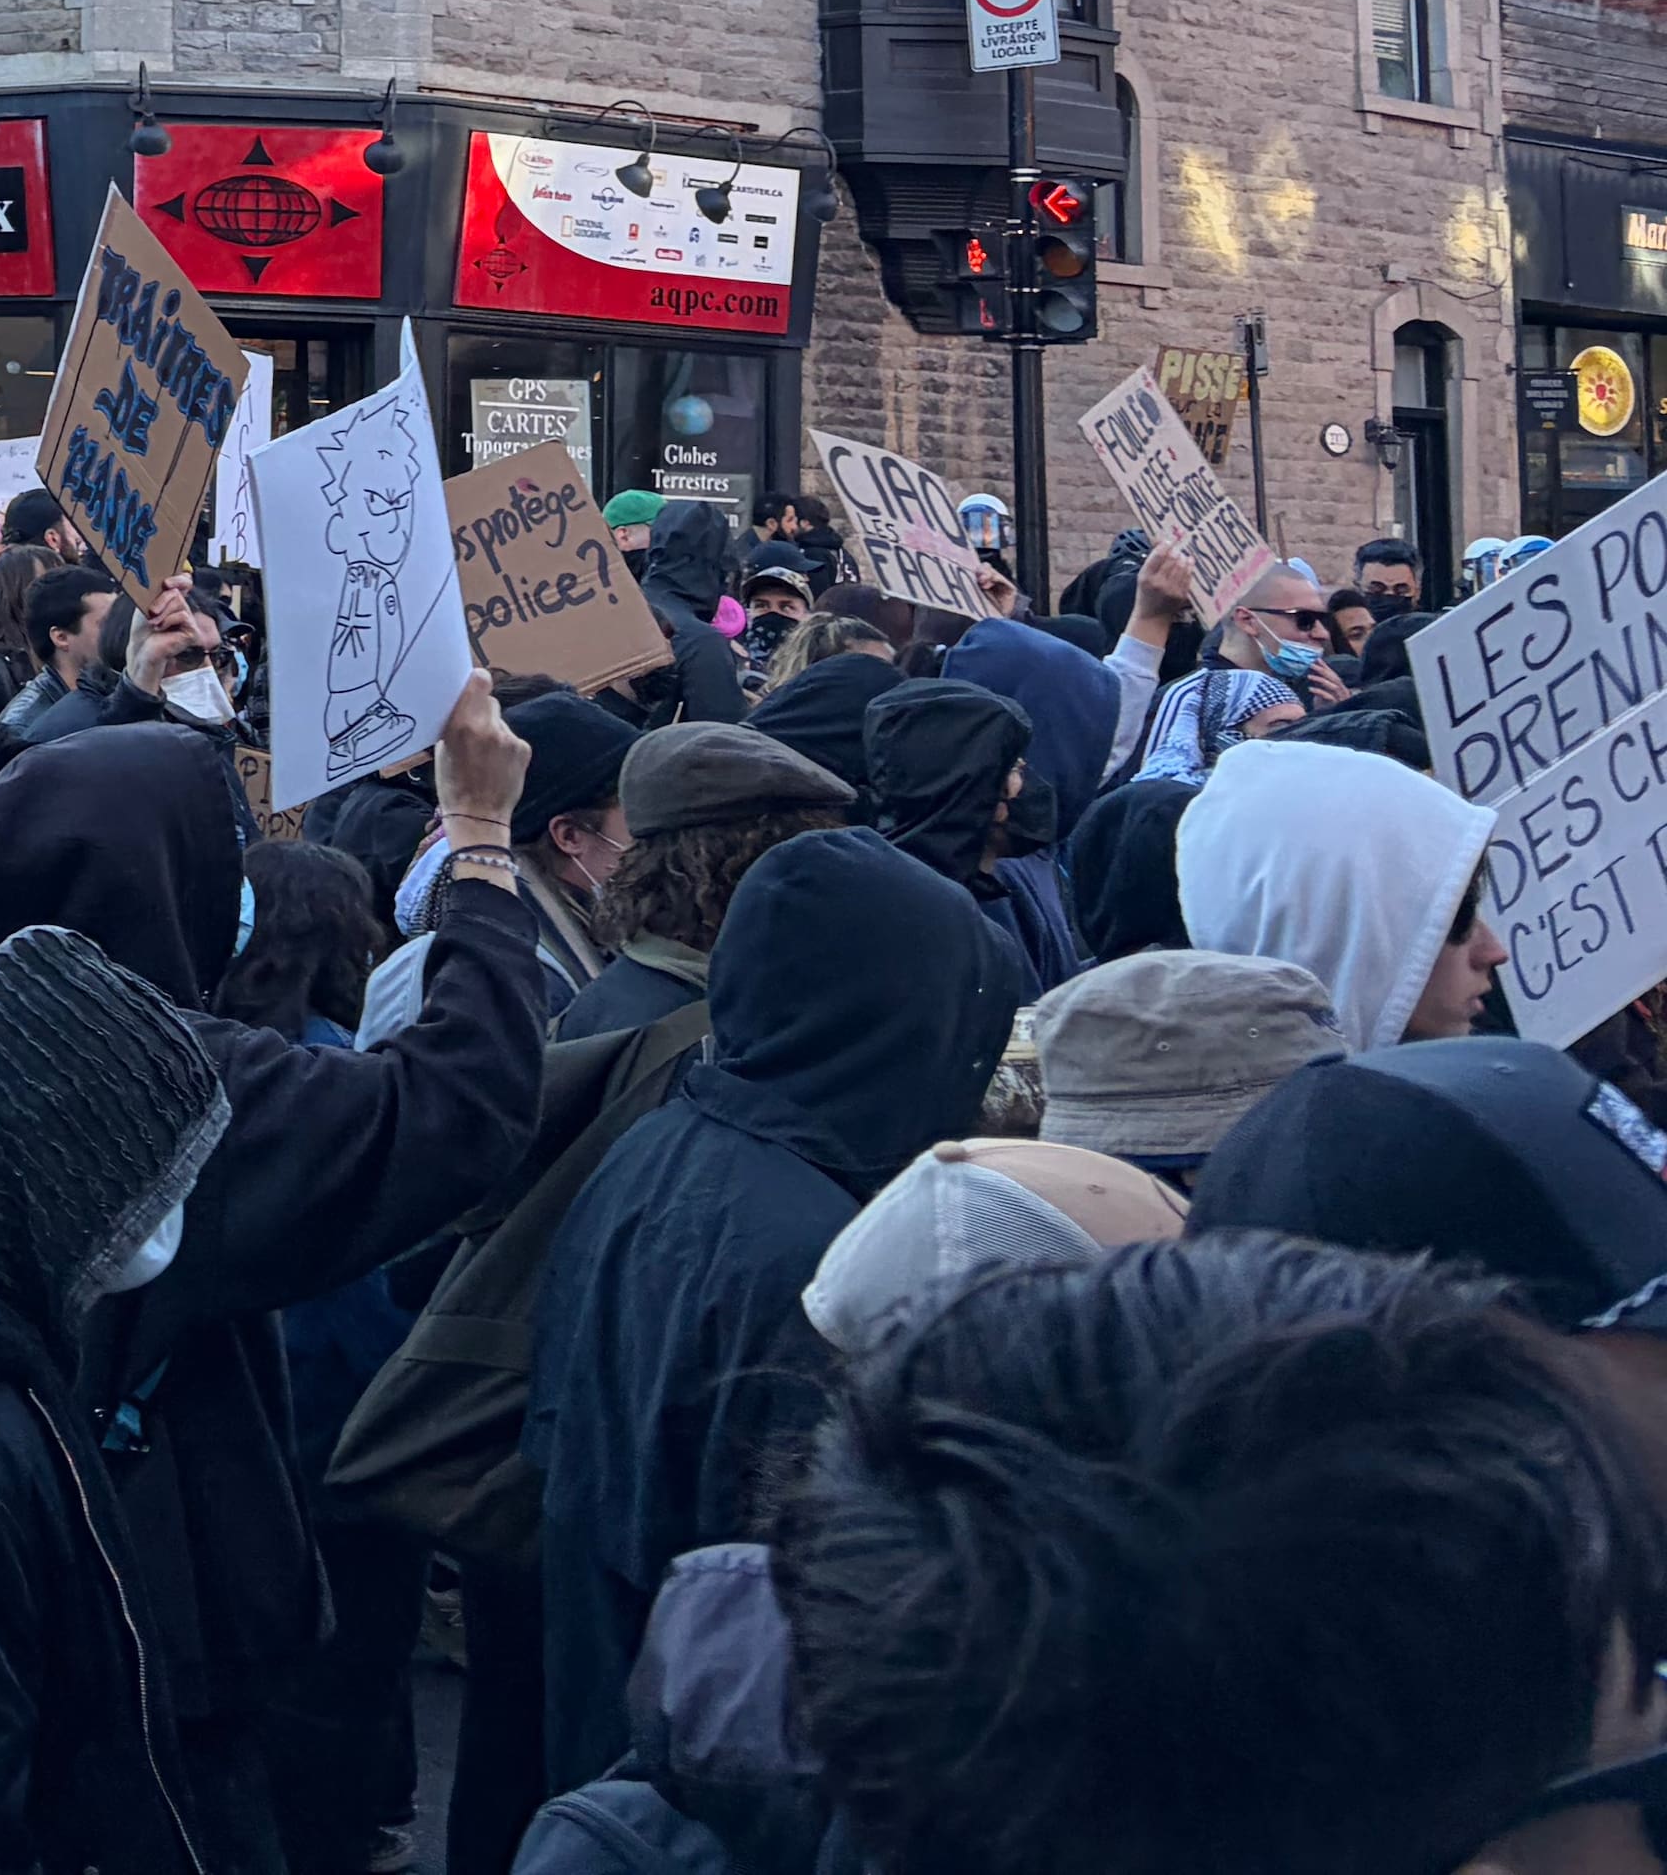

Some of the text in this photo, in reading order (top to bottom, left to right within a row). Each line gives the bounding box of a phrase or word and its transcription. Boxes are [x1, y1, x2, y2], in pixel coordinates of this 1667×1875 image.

[981, 31, 1046, 48] LIVRAISON
[986, 18, 1038, 36] EXCEPTÉ
[991, 44, 1037, 59] LOCALE
[1627, 212, 1667, 251] Mar
[650, 285, 779, 318] aqpc.com
[93, 356, 159, 457] DE
[508, 377, 547, 402] GPS
[487, 411, 567, 436] CARTES
[1094, 393, 1155, 473] FOULE
[663, 443, 718, 466] Globes
[651, 468, 730, 493] Terrestres
[828, 445, 970, 552] CIAO
[472, 477, 587, 575] protège
[856, 512, 900, 544] LES
[464, 538, 620, 668] police?
[1438, 573, 1573, 729] LES
[1487, 774, 1604, 916] DES
[1510, 855, 1636, 1002] C'EST
